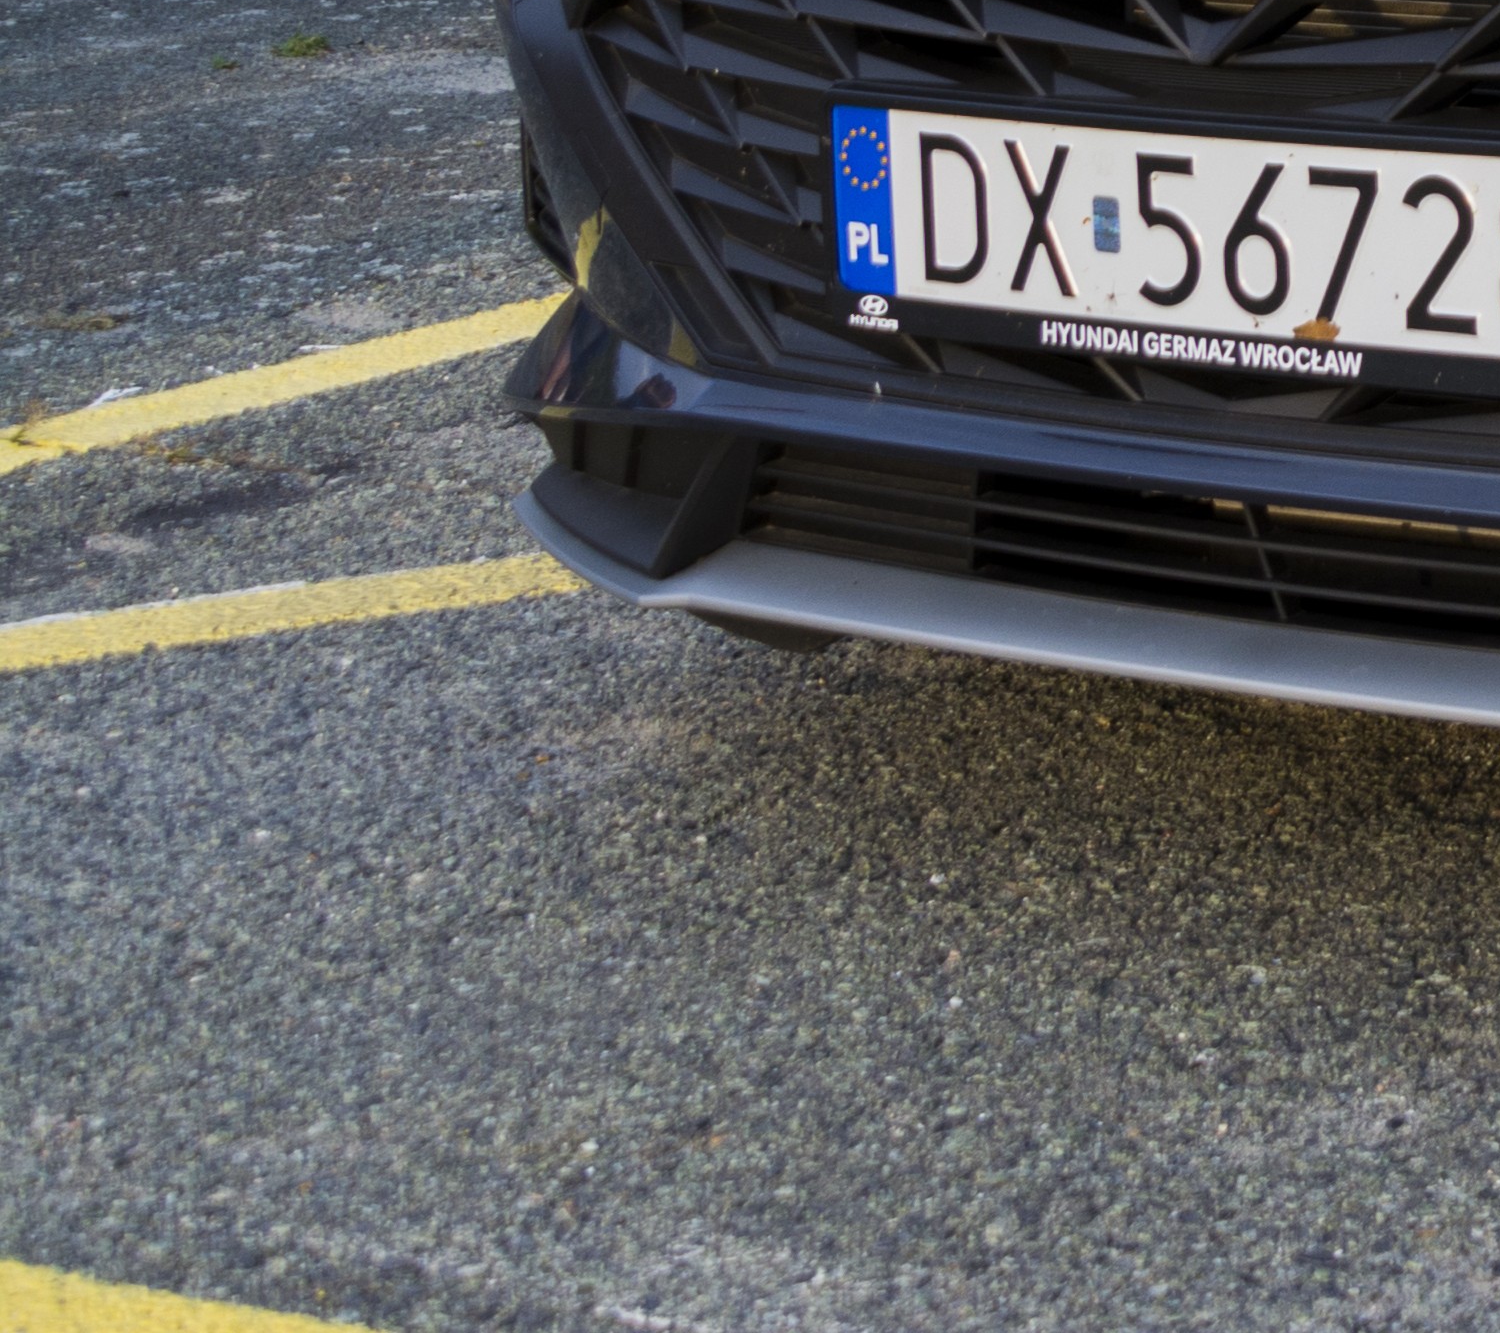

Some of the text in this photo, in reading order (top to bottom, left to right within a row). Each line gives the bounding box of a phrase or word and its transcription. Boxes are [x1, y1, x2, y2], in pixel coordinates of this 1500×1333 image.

[918, 131, 1078, 297] DX
[847, 221, 889, 266] PL
[848, 313, 898, 332] HYUNDAI
[1040, 320, 1363, 377] HYUNDAI GERMAZ WROCŁAW
